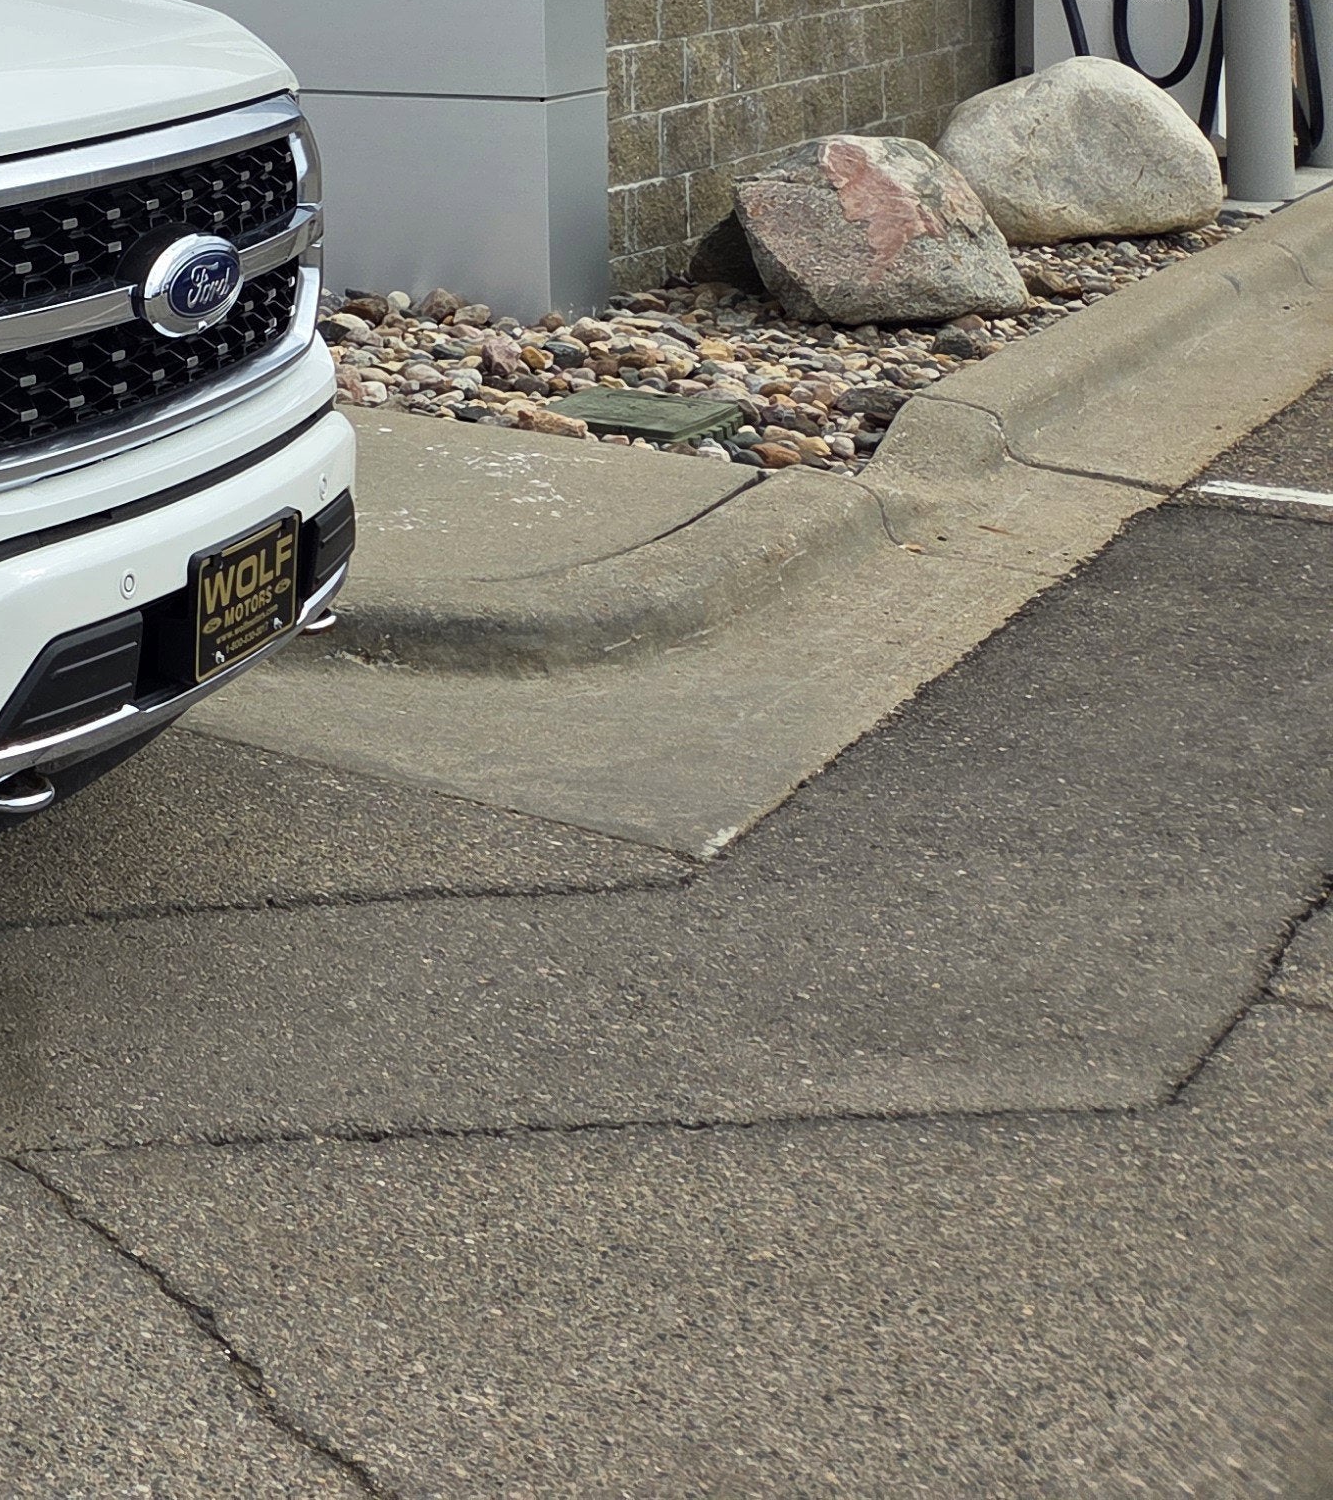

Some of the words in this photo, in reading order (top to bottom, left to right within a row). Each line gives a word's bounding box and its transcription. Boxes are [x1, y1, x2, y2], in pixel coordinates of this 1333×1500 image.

[187, 261, 231, 309] Ford
[203, 533, 293, 615] WOLF
[224, 585, 273, 628] MOTORS
